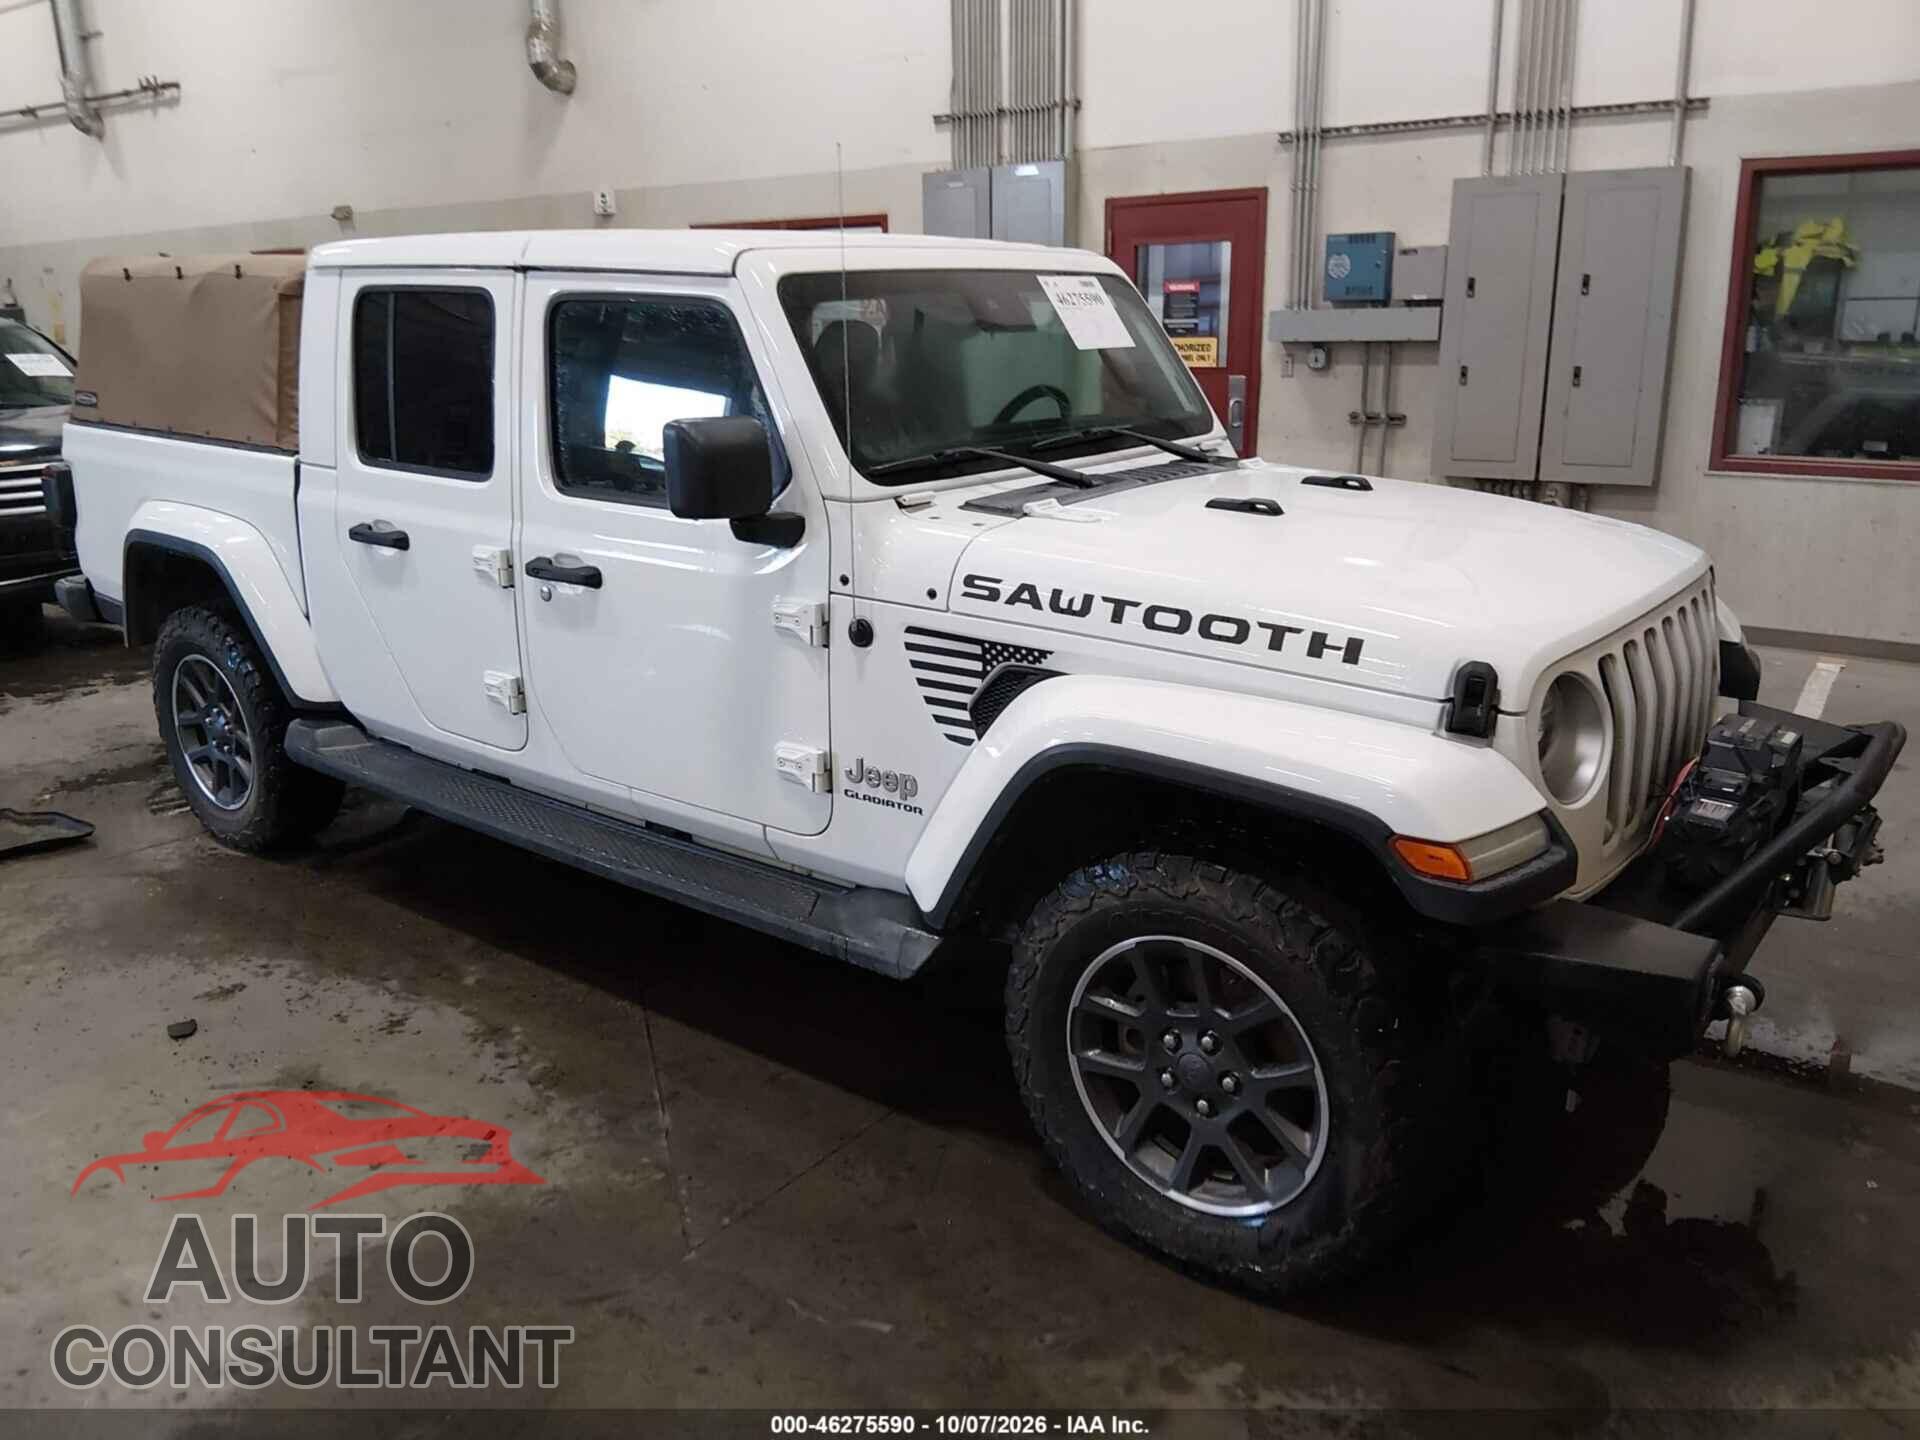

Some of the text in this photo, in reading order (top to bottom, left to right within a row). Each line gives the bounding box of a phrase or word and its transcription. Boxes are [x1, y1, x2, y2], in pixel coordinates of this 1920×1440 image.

[961, 573, 1365, 666] SAWTOOTH
[844, 757, 918, 801] Jeep
[843, 788, 924, 816] GLADIATOR
